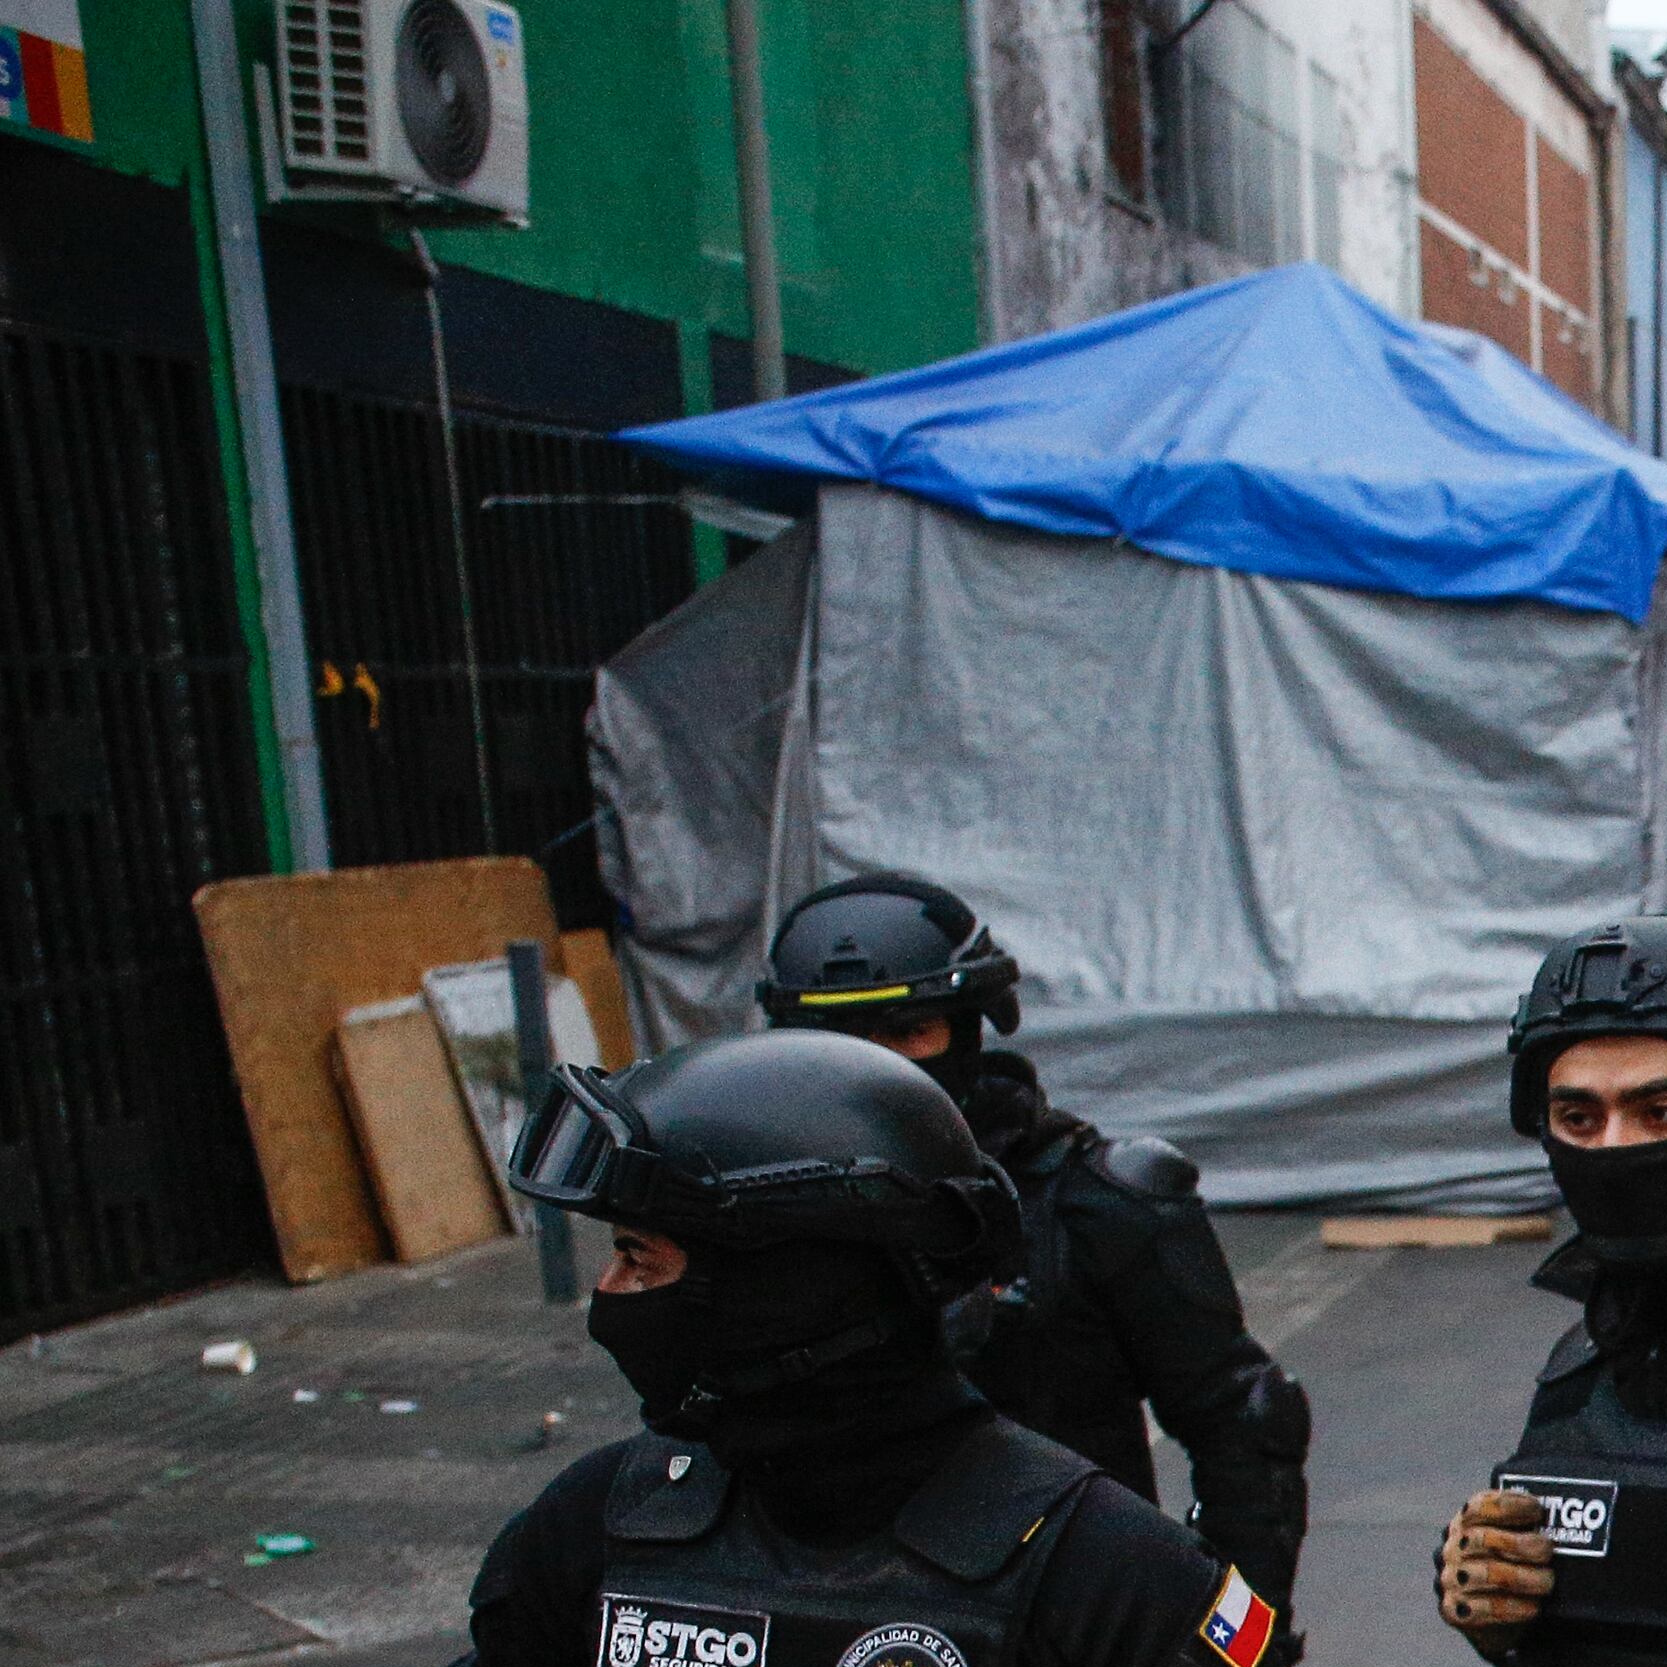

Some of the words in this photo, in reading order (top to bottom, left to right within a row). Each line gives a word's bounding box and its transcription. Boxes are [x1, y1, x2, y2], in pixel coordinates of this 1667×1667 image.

[1538, 1495, 1607, 1531] TGO
[644, 1620, 757, 1667] STGO
[923, 1633, 942, 1652] DE
